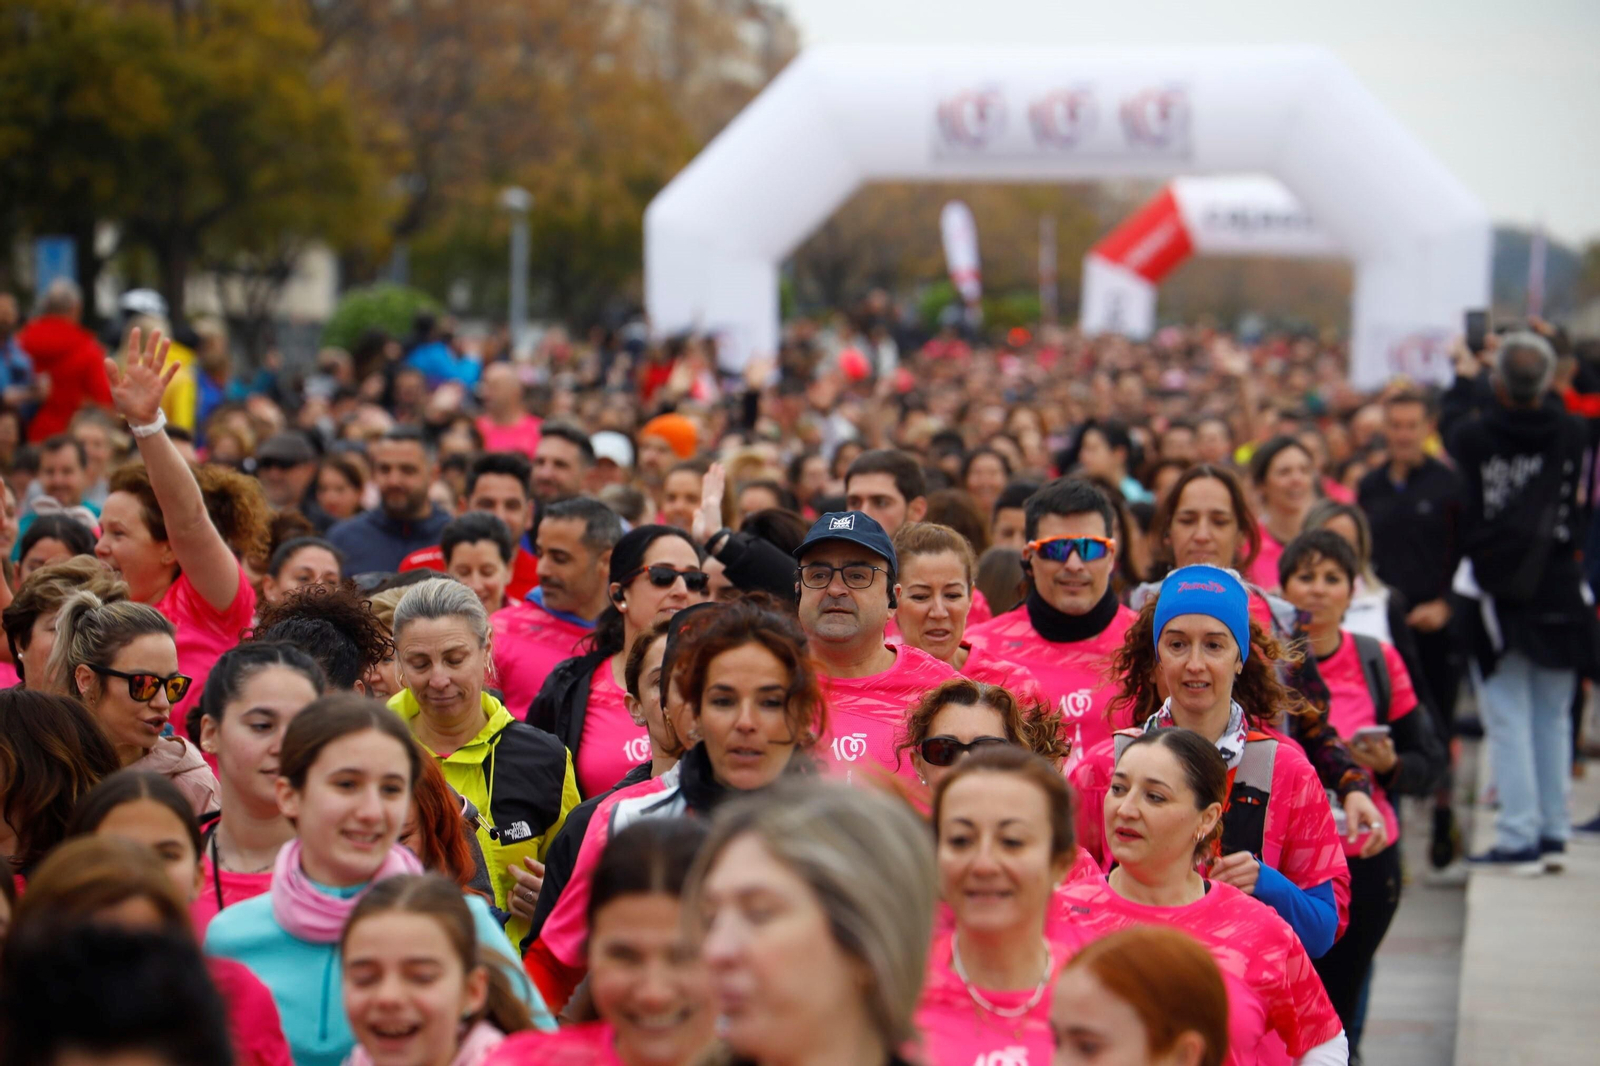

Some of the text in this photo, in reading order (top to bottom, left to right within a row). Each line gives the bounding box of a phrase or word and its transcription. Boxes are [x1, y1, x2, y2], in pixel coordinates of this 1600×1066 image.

[830, 735, 867, 762] 100
[511, 821, 523, 830] THE
[504, 826, 525, 837] NORTH
[511, 831, 526, 841] FACE
